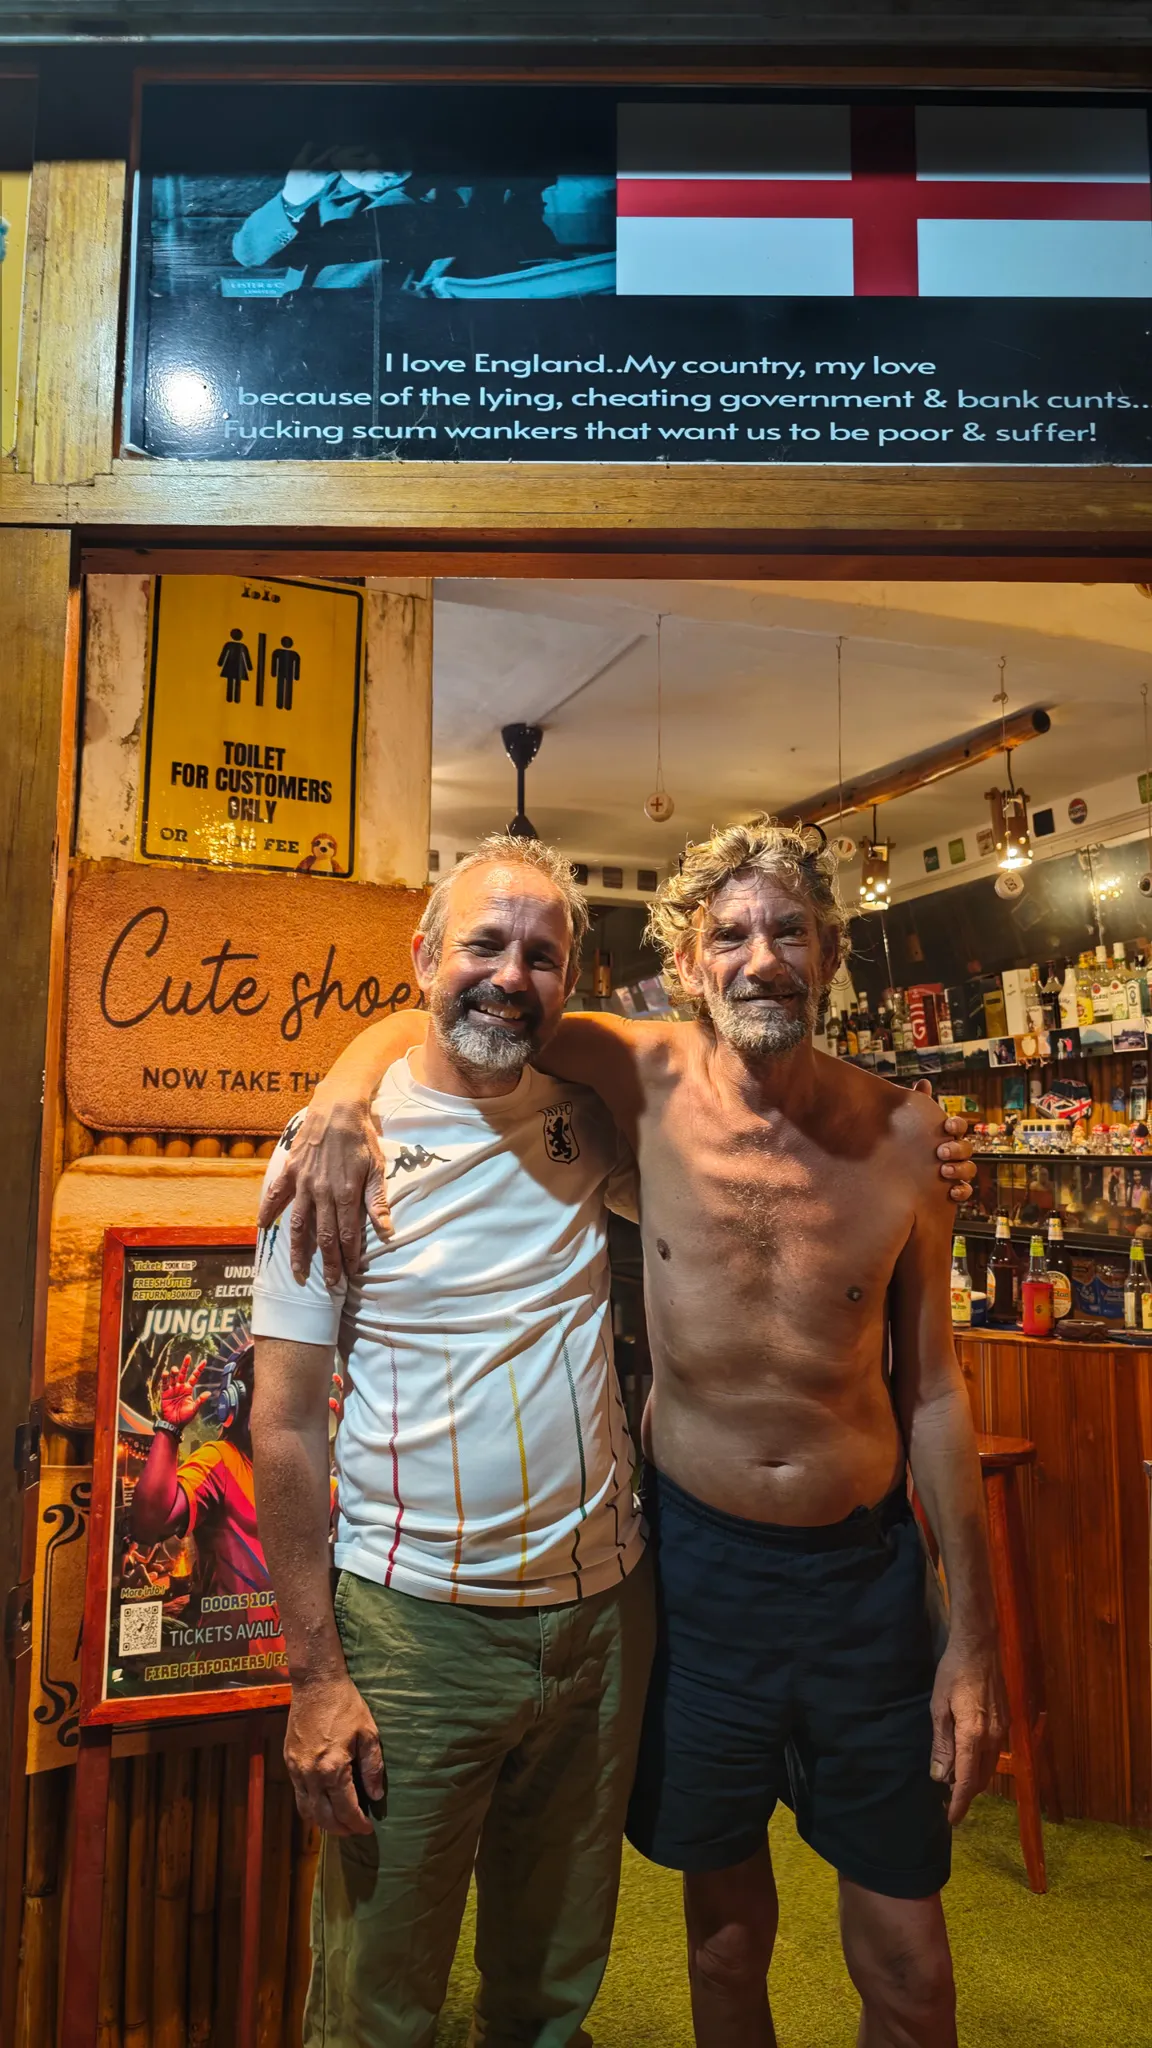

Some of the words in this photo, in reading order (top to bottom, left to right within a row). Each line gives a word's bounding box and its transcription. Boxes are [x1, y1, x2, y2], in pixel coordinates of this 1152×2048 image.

[385, 352, 393, 374] I
[402, 352, 467, 374] love
[682, 357, 806, 380] country,
[815, 361, 866, 380] my
[873, 355, 937, 375] love
[237, 385, 372, 407] because
[379, 386, 414, 407] of
[419, 387, 471, 407] the
[479, 387, 563, 412] lying,
[571, 388, 712, 412] cheating
[719, 390, 915, 412] government
[923, 389, 948, 409] &
[957, 389, 1040, 410] bank
[222, 419, 343, 445] Fucking
[351, 423, 437, 441] scum
[444, 421, 578, 441] wankers
[584, 421, 652, 441] that
[658, 423, 740, 442] want
[747, 427, 782, 442] us
[788, 424, 821, 442] to
[830, 422, 870, 442] be
[878, 428, 954, 447] poor
[962, 423, 986, 442] &
[996, 422, 1097, 443] suffer!
[223, 741, 286, 772] TOILET
[171, 762, 209, 789] FOR
[215, 768, 333, 805] CUSTOMERS
[227, 796, 277, 825] ONLY
[160, 828, 188, 843] OR
[264, 837, 300, 854] FEE
[100, 905, 270, 1030] Cute
[142, 1066, 208, 1090] NOW
[218, 1069, 281, 1092] TAKE
[289, 1071, 324, 1093] TH
[544, 1104, 572, 1117] AVFC
[132, 1289, 167, 1301] RETURN
[133, 1277, 153, 1289] FREE
[154, 1277, 192, 1288] SHUTTLE
[141, 1307, 238, 1342] JUNGLE
[120, 1586, 144, 1600] More
[201, 1594, 249, 1613] DOORS
[169, 1626, 233, 1647] TICKETS
[144, 1663, 179, 1682] FIRE
[179, 1656, 265, 1677] PERFORMERS
